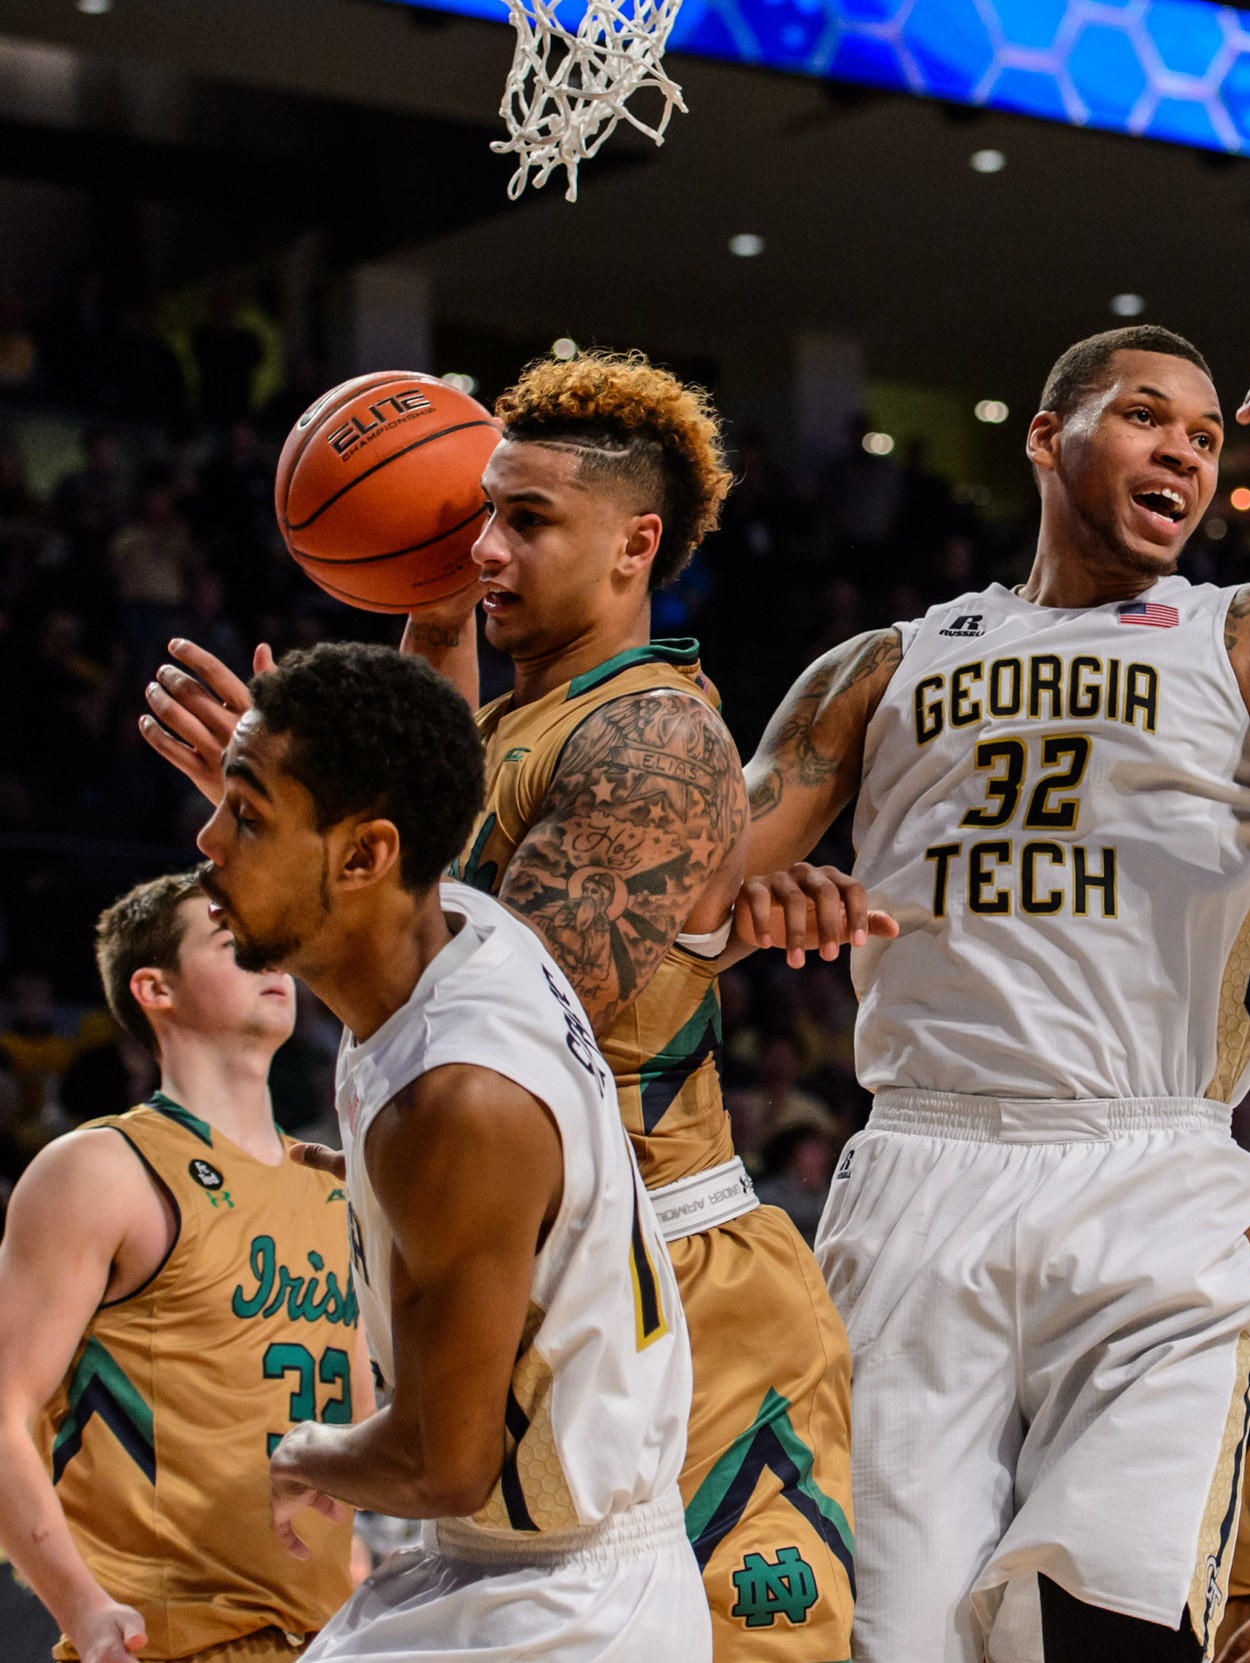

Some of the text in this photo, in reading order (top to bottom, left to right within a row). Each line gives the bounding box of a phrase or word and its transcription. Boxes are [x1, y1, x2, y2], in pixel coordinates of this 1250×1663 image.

[327, 389, 431, 455] ELITE
[342, 408, 436, 463] CHAMPIONSHIP
[914, 654, 1160, 746] GEORGIA
[643, 754, 698, 781] ELIAS
[958, 734, 1092, 830] 32
[925, 839, 1118, 919] TECH
[709, 1184, 741, 1204] UNDER
